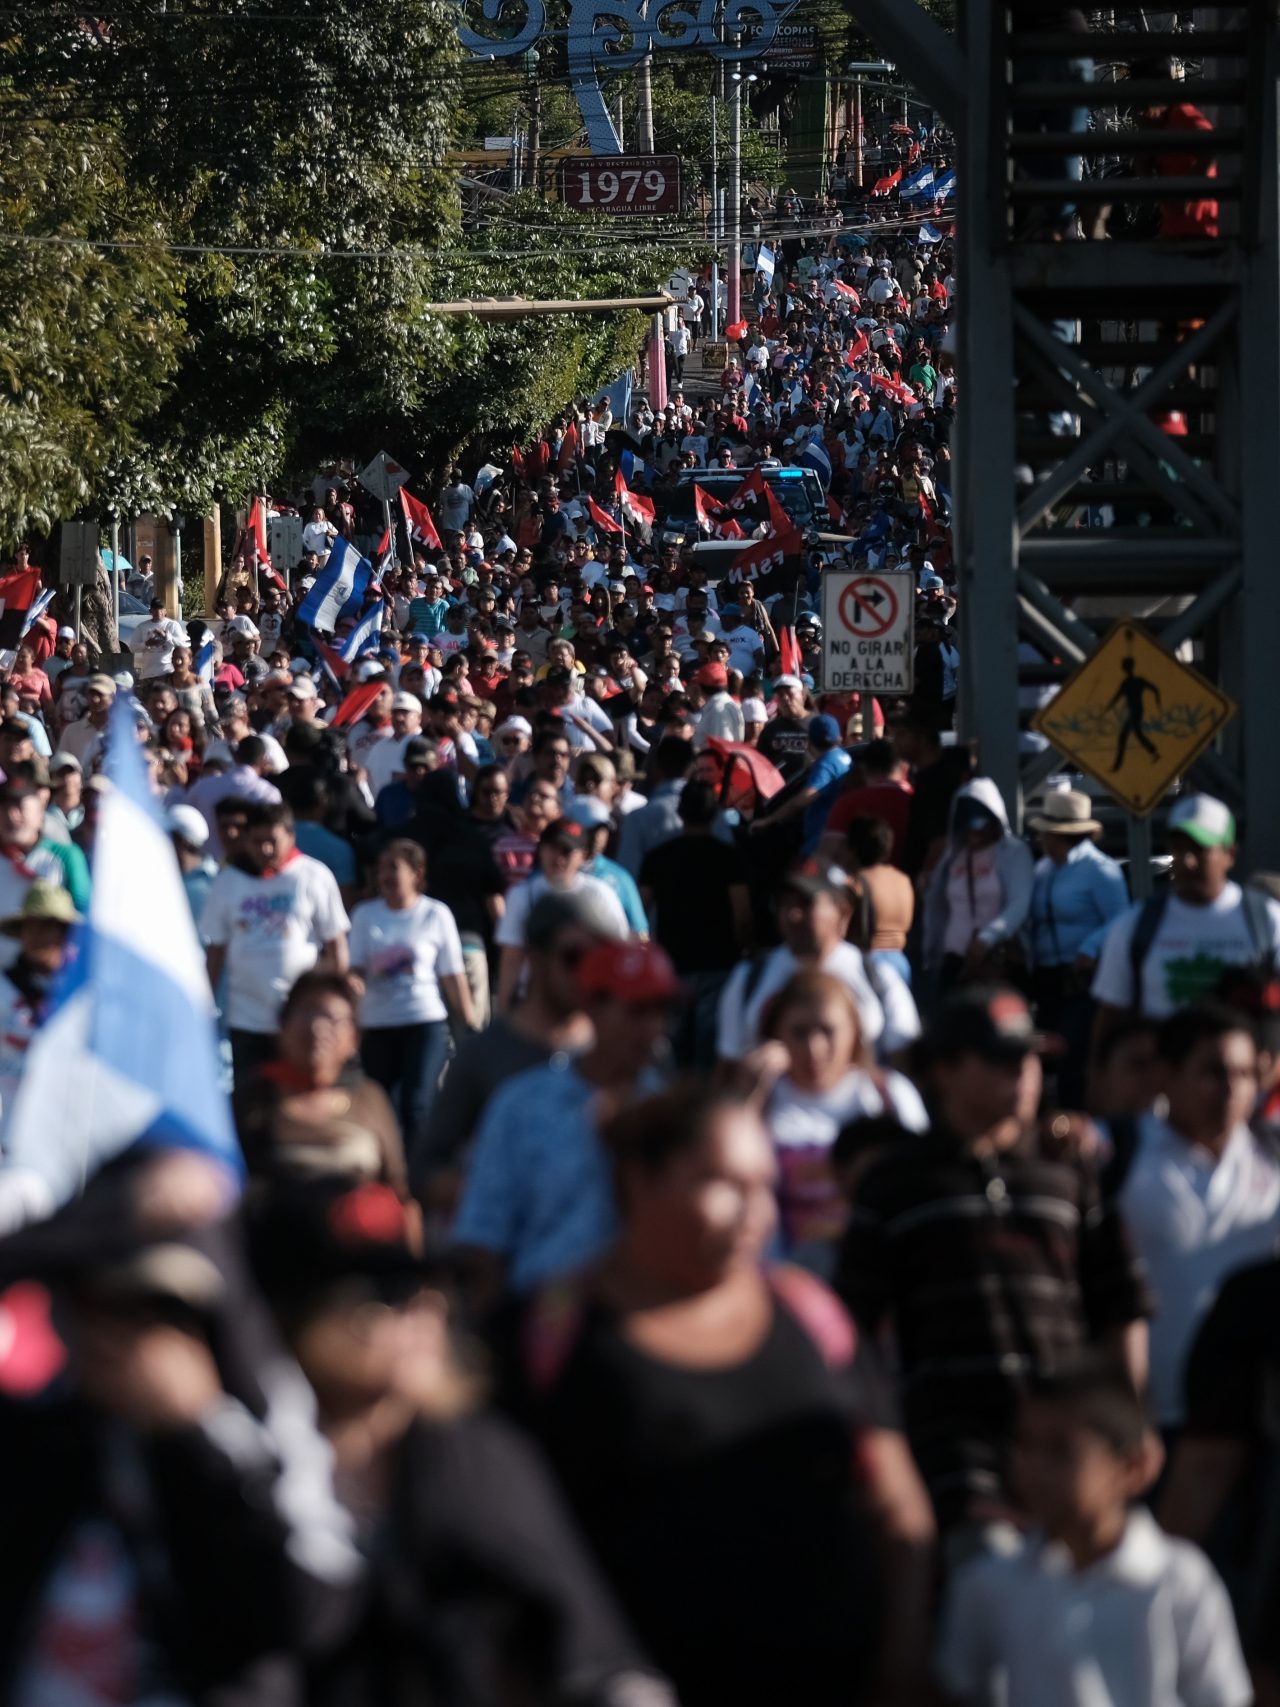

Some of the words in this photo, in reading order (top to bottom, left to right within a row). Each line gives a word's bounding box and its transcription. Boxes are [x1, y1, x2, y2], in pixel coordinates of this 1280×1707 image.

[750, 25, 815, 36] FOCOPIAS
[578, 170, 666, 203] 1979
[634, 204, 657, 212] LIBRE
[830, 641, 850, 656] NO
[858, 641, 903, 656] GIRAR
[850, 658, 857, 670] A
[865, 658, 884, 670] LA
[832, 672, 904, 687] DERECHA
